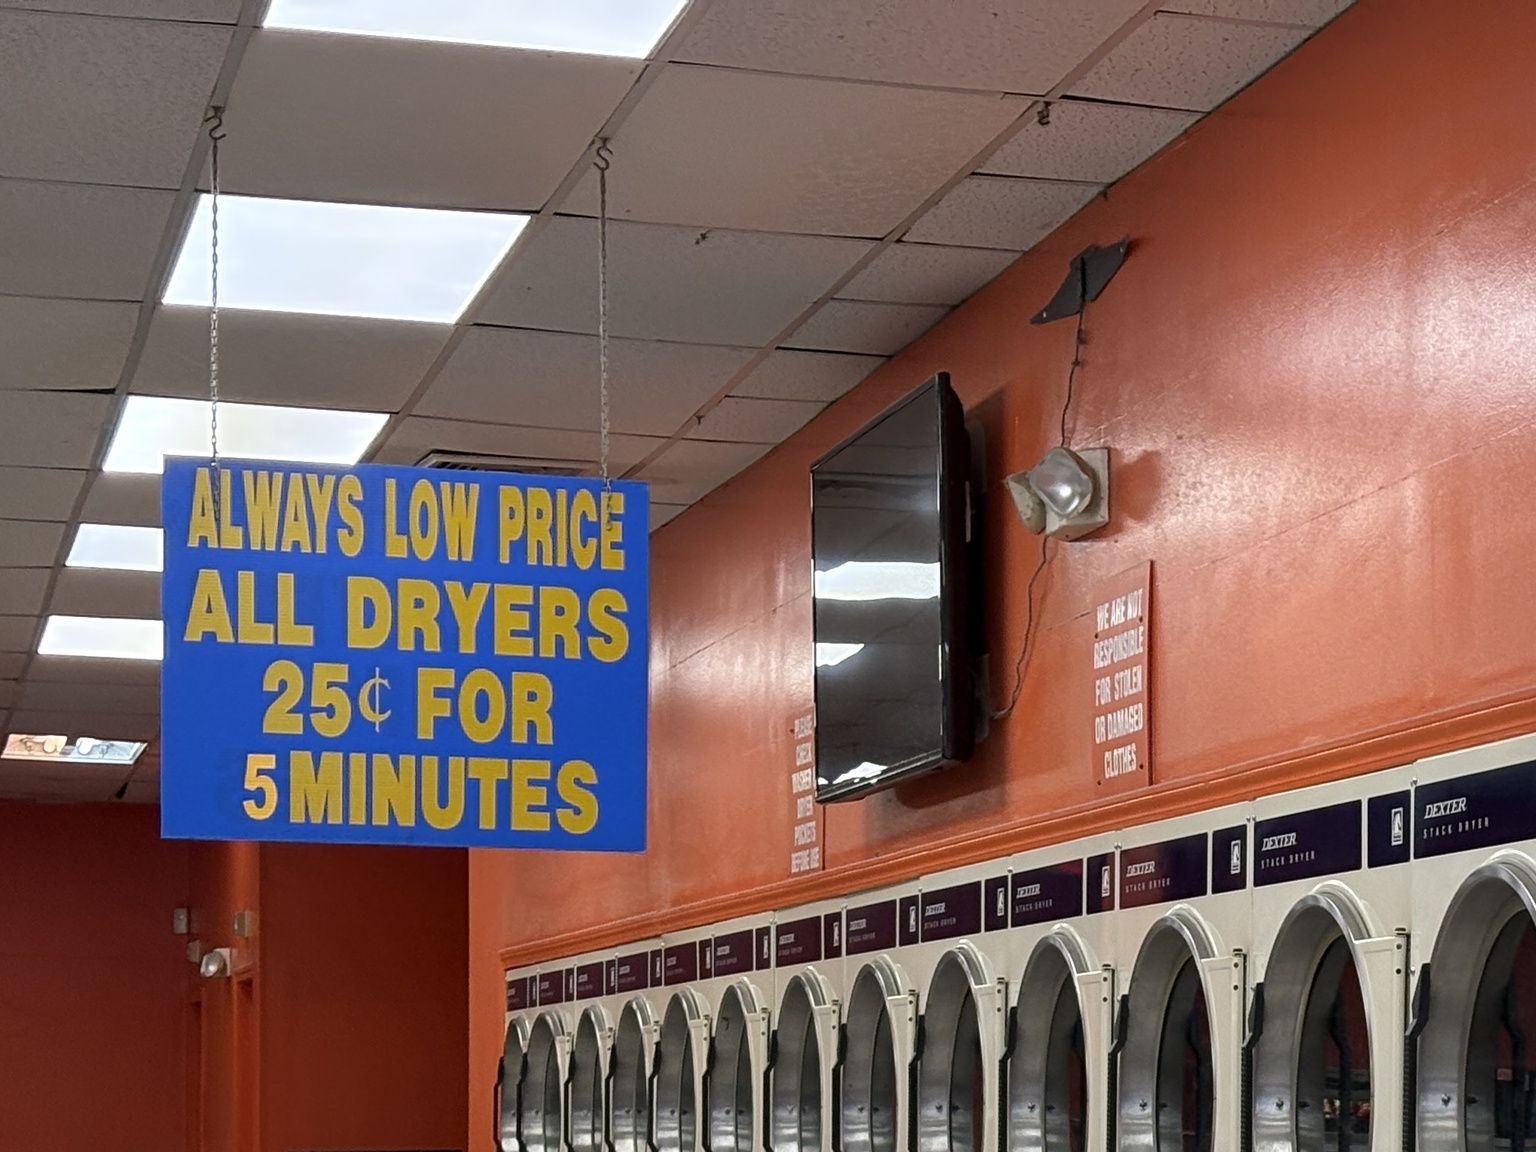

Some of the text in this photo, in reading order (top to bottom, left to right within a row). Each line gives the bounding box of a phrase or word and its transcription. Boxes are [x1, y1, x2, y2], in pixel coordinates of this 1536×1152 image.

[187, 467, 625, 571] ALWAYS LOW PRICE
[183, 569, 630, 663] ALL DRYERS
[1097, 588, 1143, 632] WE ARE NOT
[1094, 626, 1144, 669] RESPONSIBLE
[262, 660, 554, 745] 25¢ FOR
[1096, 664, 1142, 706] FOR STOLEN
[1095, 703, 1143, 744] OR DAMAGED
[1105, 743, 1137, 779] CLOTHES
[242, 751, 598, 835] 5 MINUTES
[1424, 797, 1467, 819] DEXTER
[1261, 832, 1297, 851] DEXTER
[1423, 816, 1489, 839] STACK DRYER
